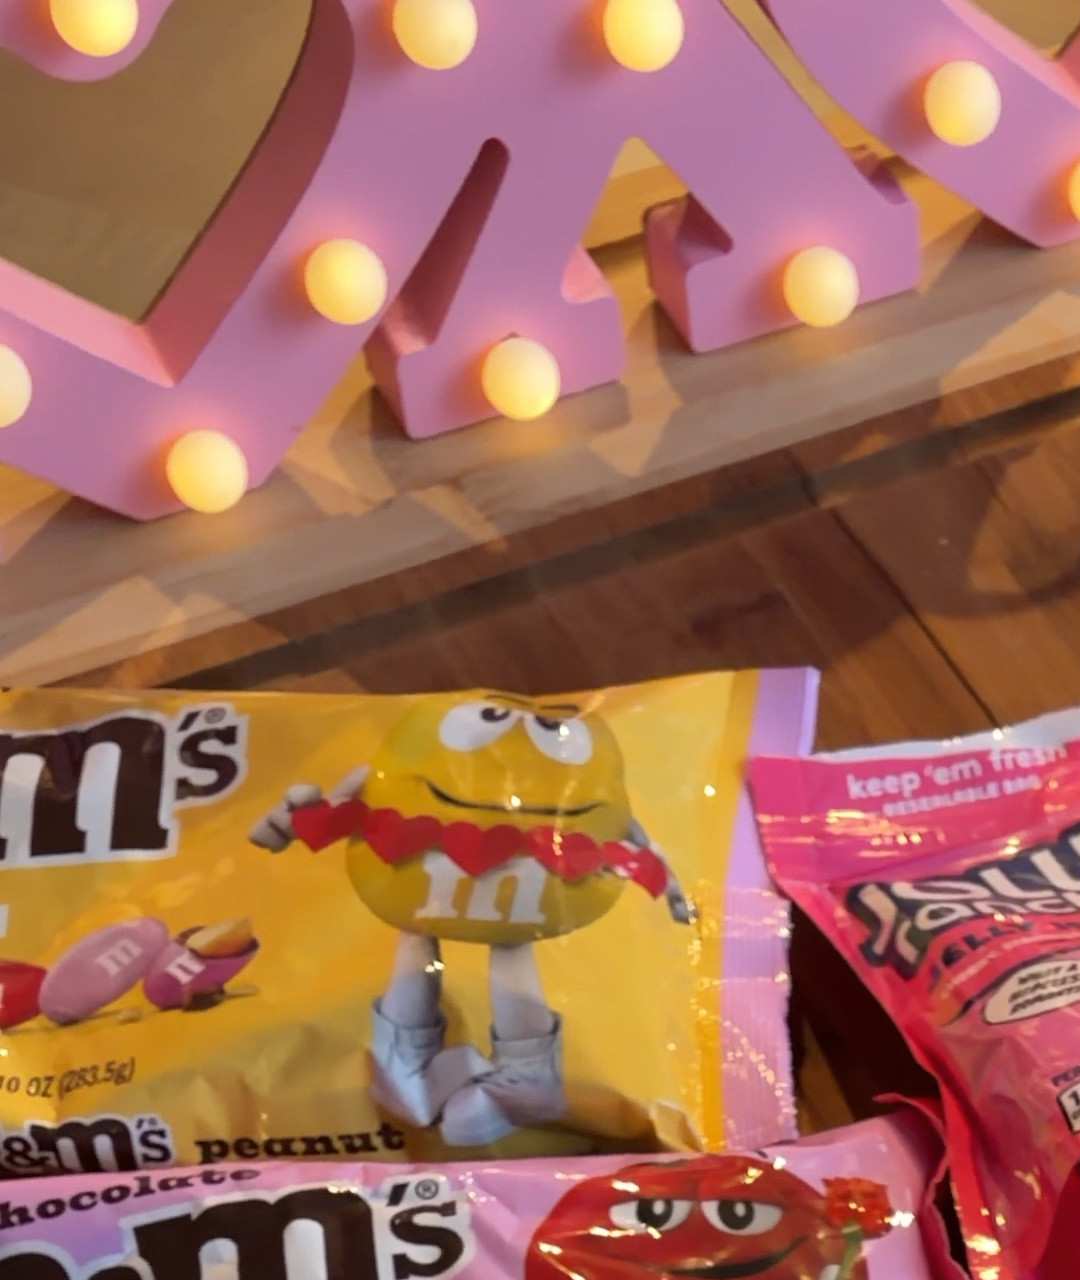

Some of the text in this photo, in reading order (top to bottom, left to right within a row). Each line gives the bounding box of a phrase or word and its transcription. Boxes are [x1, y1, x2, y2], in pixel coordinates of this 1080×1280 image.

[846, 746, 1068, 799] keep 'em fresh
[26, 1074, 53, 1099] OZ
[194, 1122, 406, 1164] peanut
